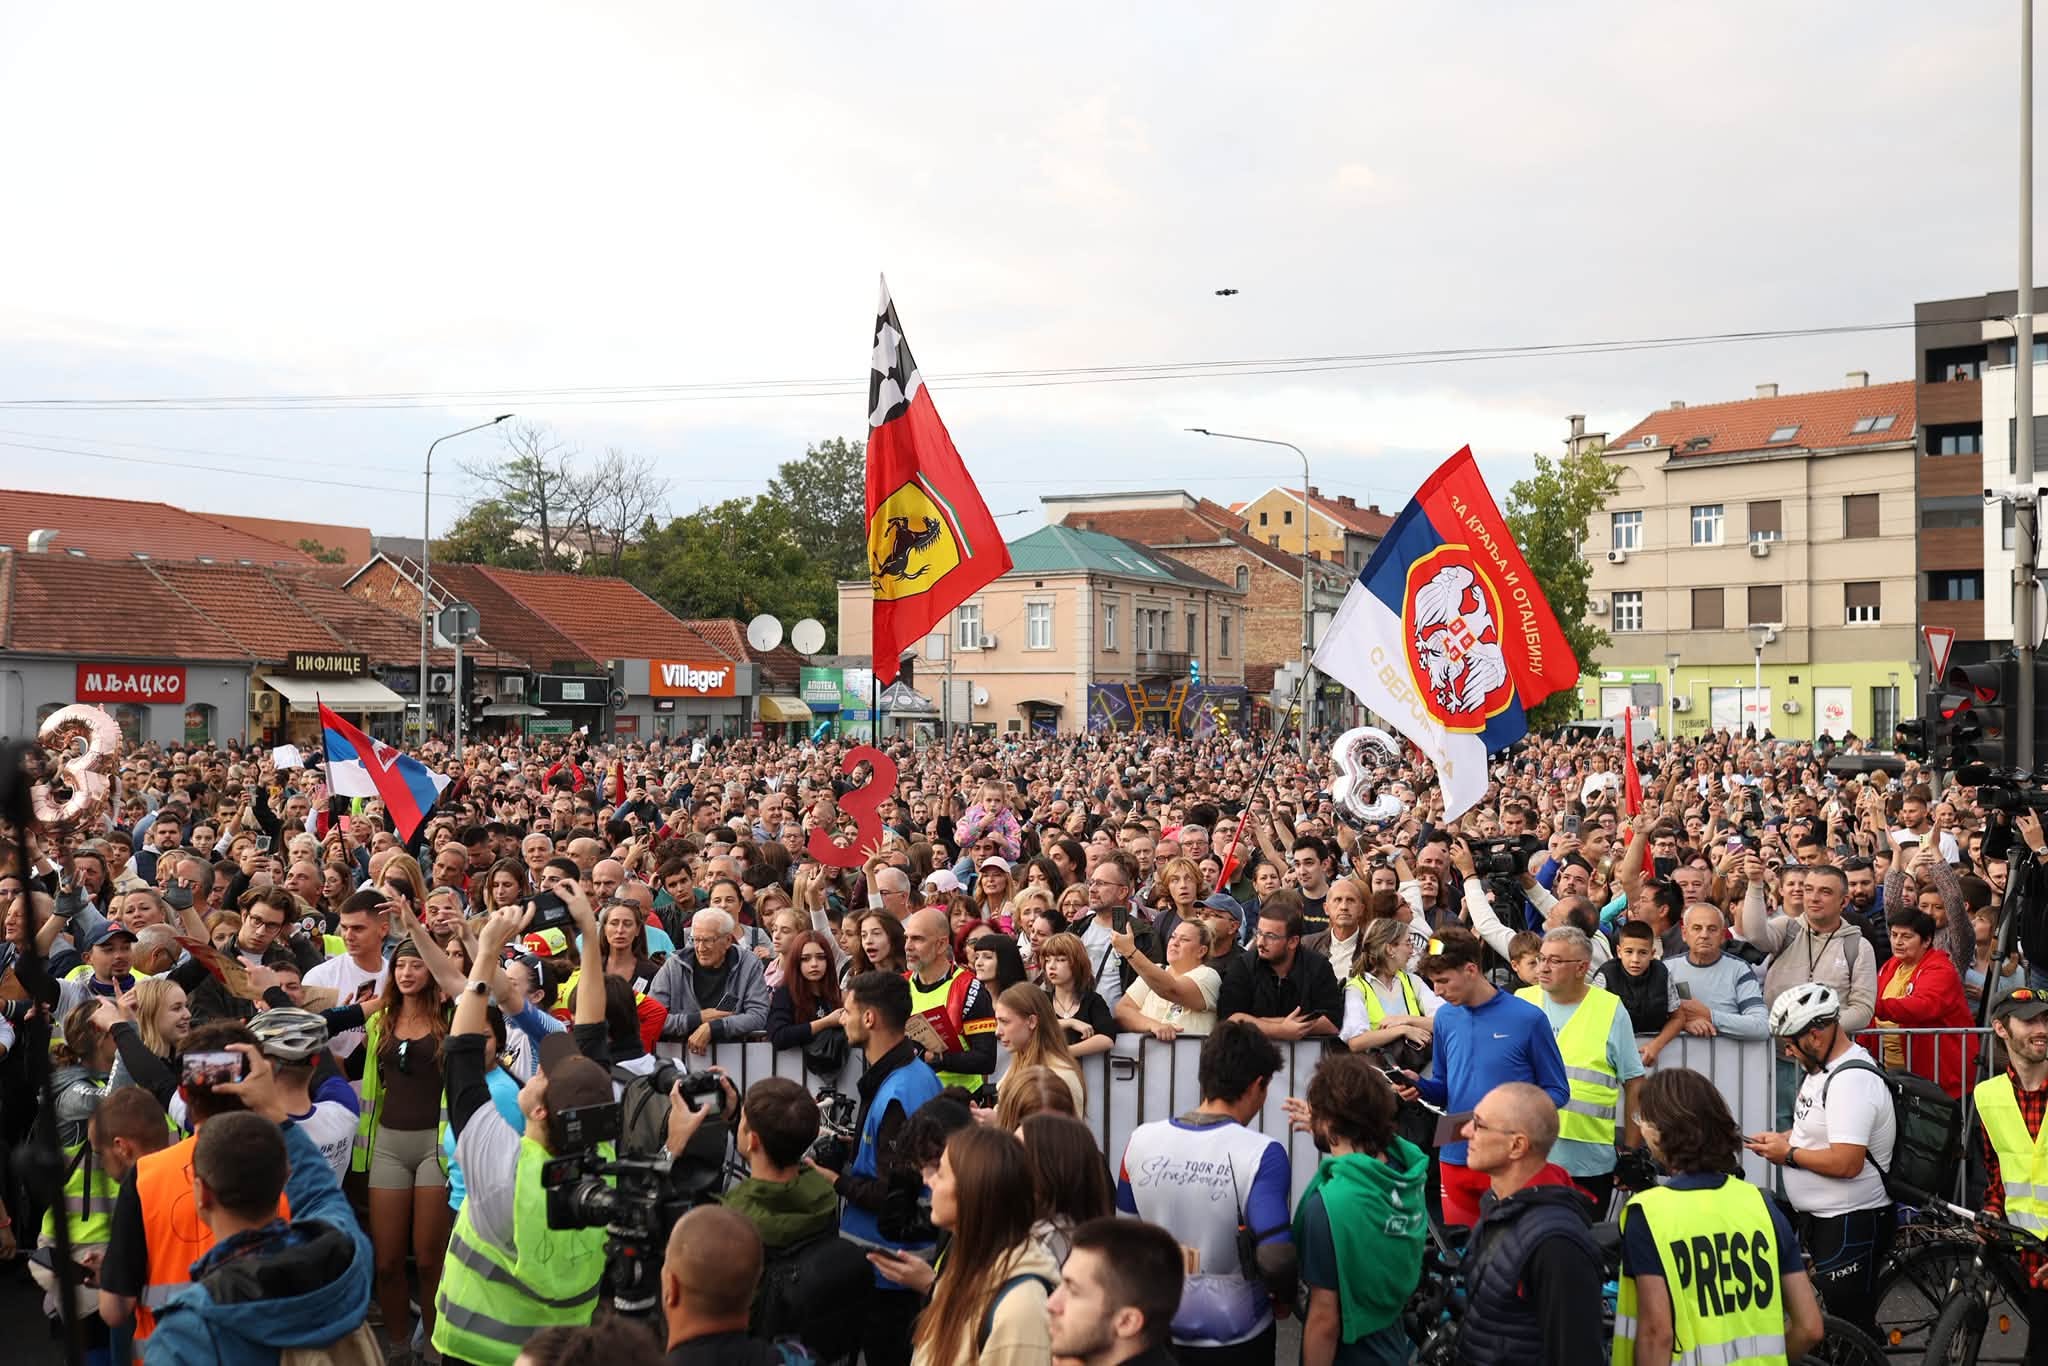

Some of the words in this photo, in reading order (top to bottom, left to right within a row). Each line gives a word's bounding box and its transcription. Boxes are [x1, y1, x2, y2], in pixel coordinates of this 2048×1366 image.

[1450, 496, 1468, 519] ЗА
[1465, 515, 1508, 573] КРАЉА
[1504, 571, 1520, 587] И
[295, 655, 361, 675] КИФЛИЦЕ
[85, 673, 180, 697] МЉАЦКО
[661, 664, 728, 693] Villager
[1185, 1160, 1214, 1174] TOUR
[1217, 1164, 1231, 1176] DE
[1670, 1230, 1773, 1317] PRESS
